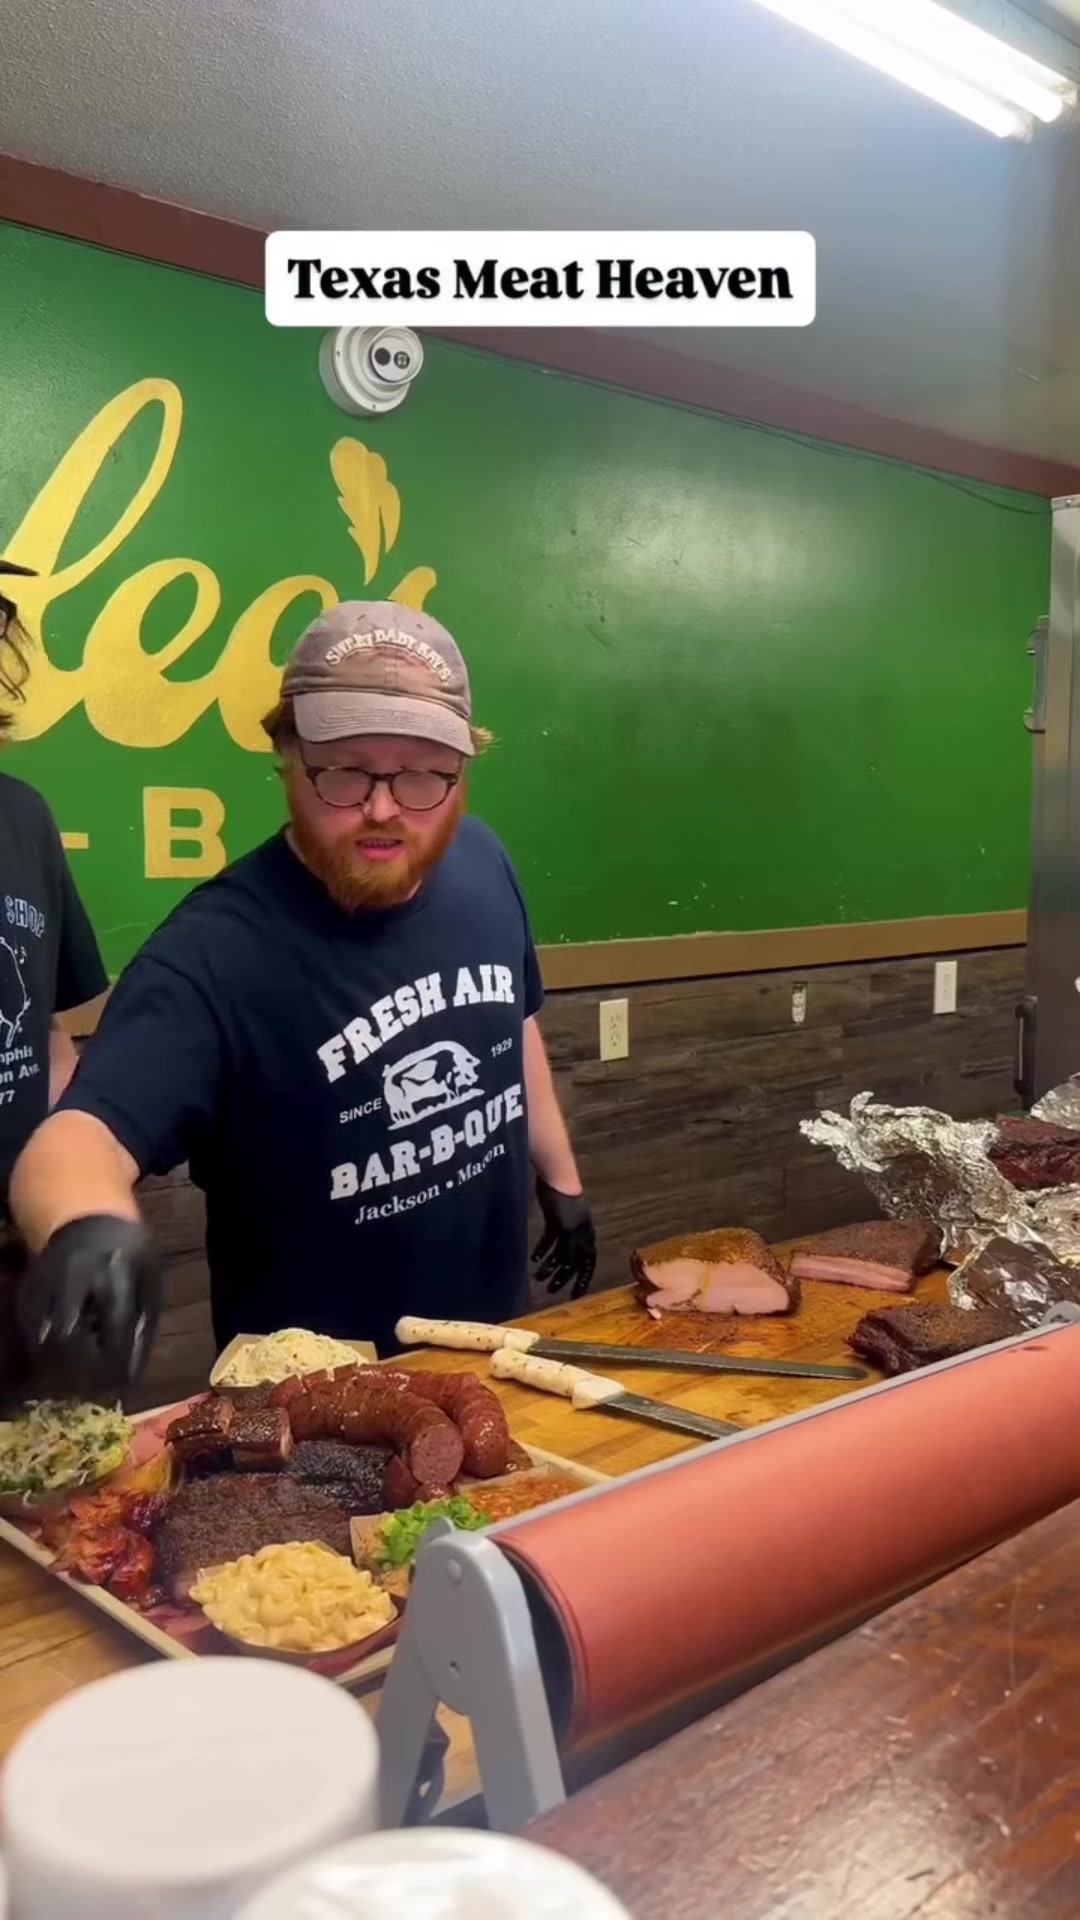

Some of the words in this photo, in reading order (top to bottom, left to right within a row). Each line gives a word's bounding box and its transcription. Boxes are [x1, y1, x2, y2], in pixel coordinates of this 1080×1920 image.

[373, 628, 418, 649] BABY
[4, 894, 46, 938] SHOP
[316, 971, 448, 1084] FRESH
[453, 964, 516, 1008] AIR
[490, 1037, 513, 1059] 1929
[339, 1097, 383, 1125] SINCE
[329, 1082, 524, 1201] BAR-B-QUE
[353, 1184, 441, 1226] Jackson
[455, 1143, 506, 1187] Macon
